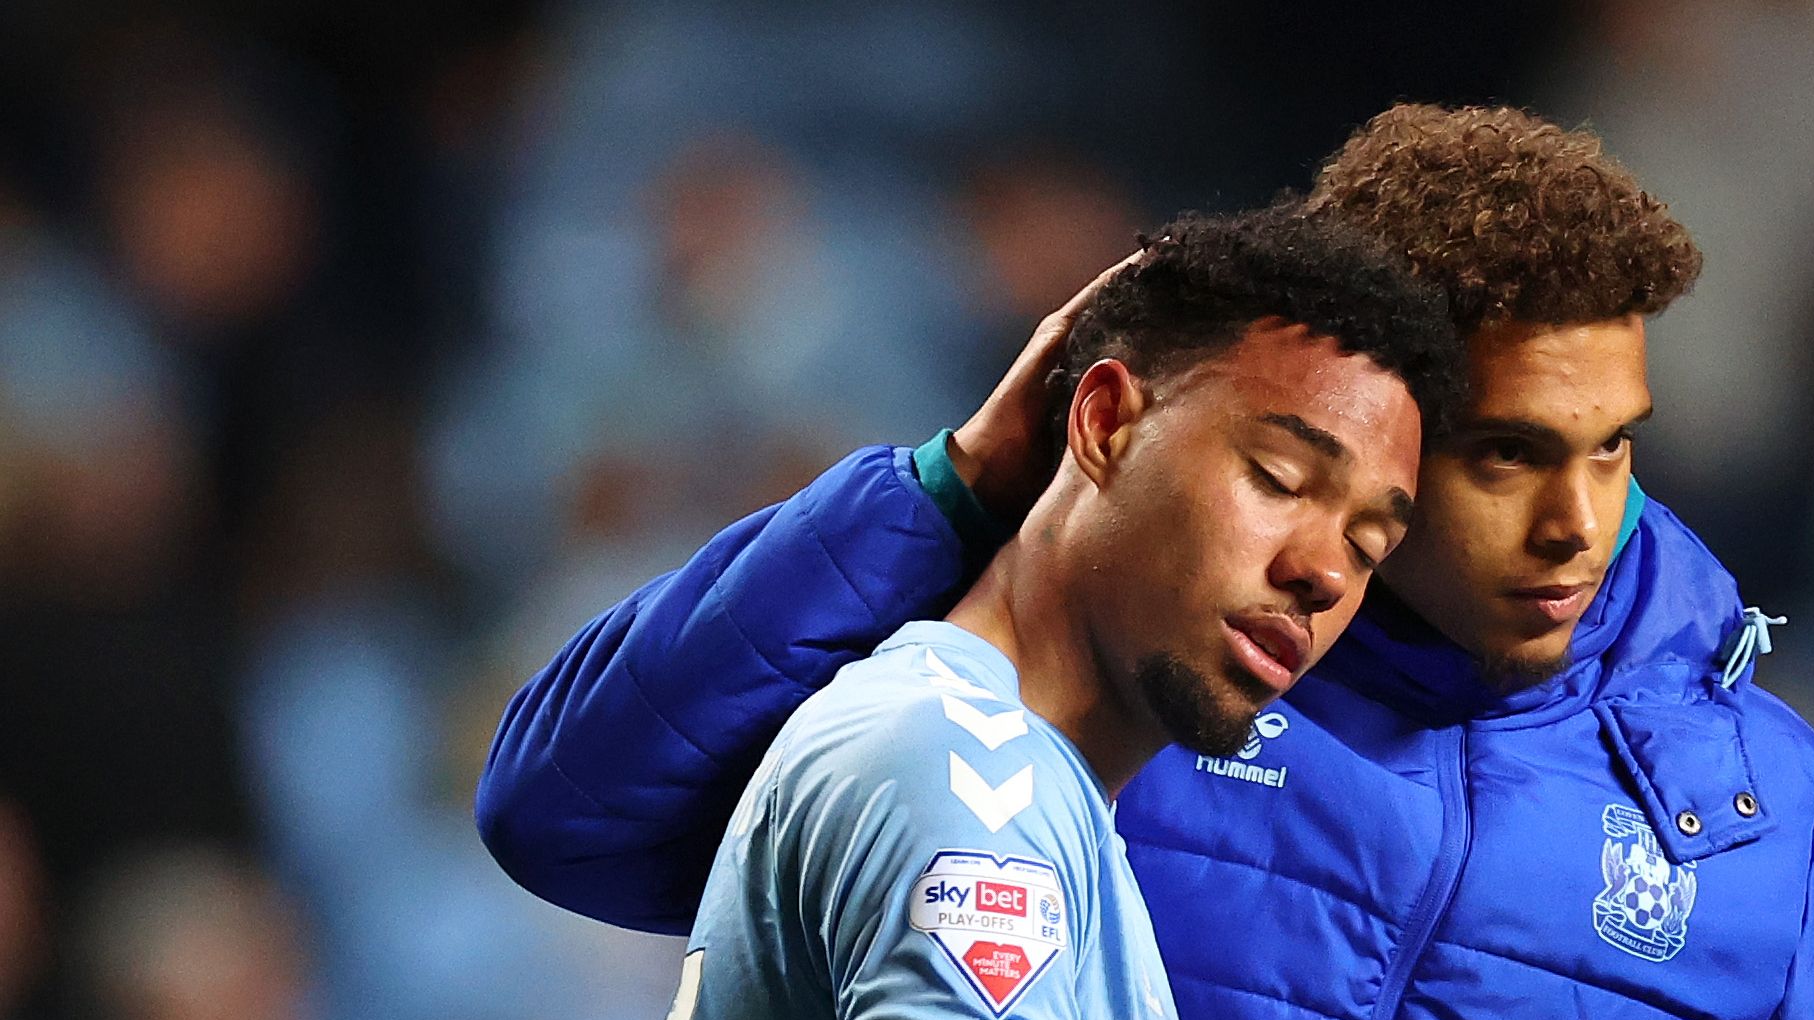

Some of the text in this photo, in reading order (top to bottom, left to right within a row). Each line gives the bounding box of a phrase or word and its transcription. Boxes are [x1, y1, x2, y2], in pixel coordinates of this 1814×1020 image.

[1195, 754, 1287, 788] hummel
[925, 880, 1024, 911] sky bet
[938, 912, 1015, 931] PLAY-OFFS
[1041, 925, 1061, 941] EFL
[973, 957, 1011, 970] MINUTE
[992, 950, 1021, 963] EVERY
[979, 967, 1020, 979] MATTERS
